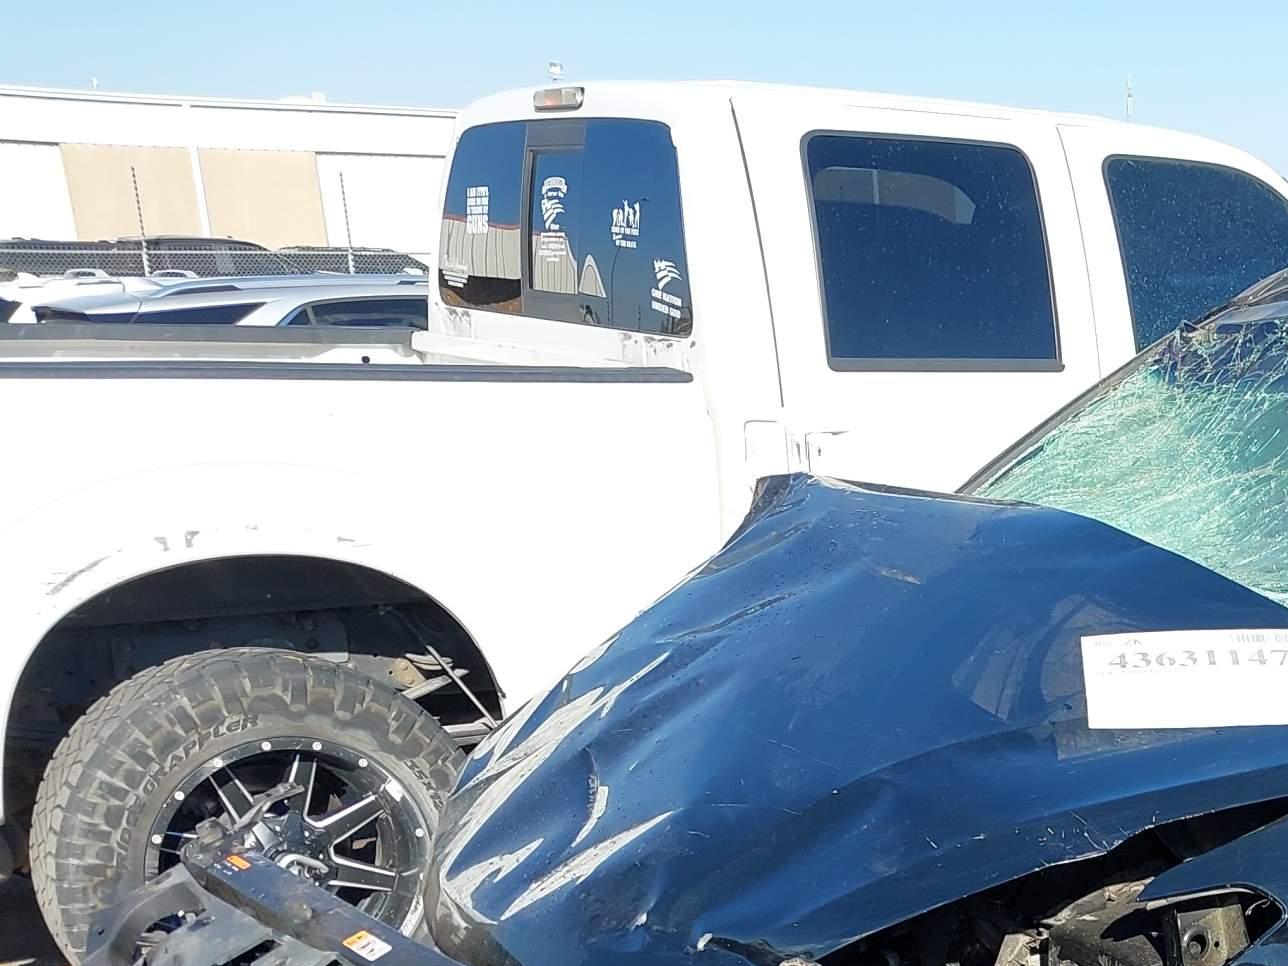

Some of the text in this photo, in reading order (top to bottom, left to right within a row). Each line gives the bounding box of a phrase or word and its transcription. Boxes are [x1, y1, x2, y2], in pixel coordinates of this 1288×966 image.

[467, 215, 489, 234] GUNS
[1109, 649, 1288, 668] 43631147
[143, 714, 259, 796] GRAPPLER
